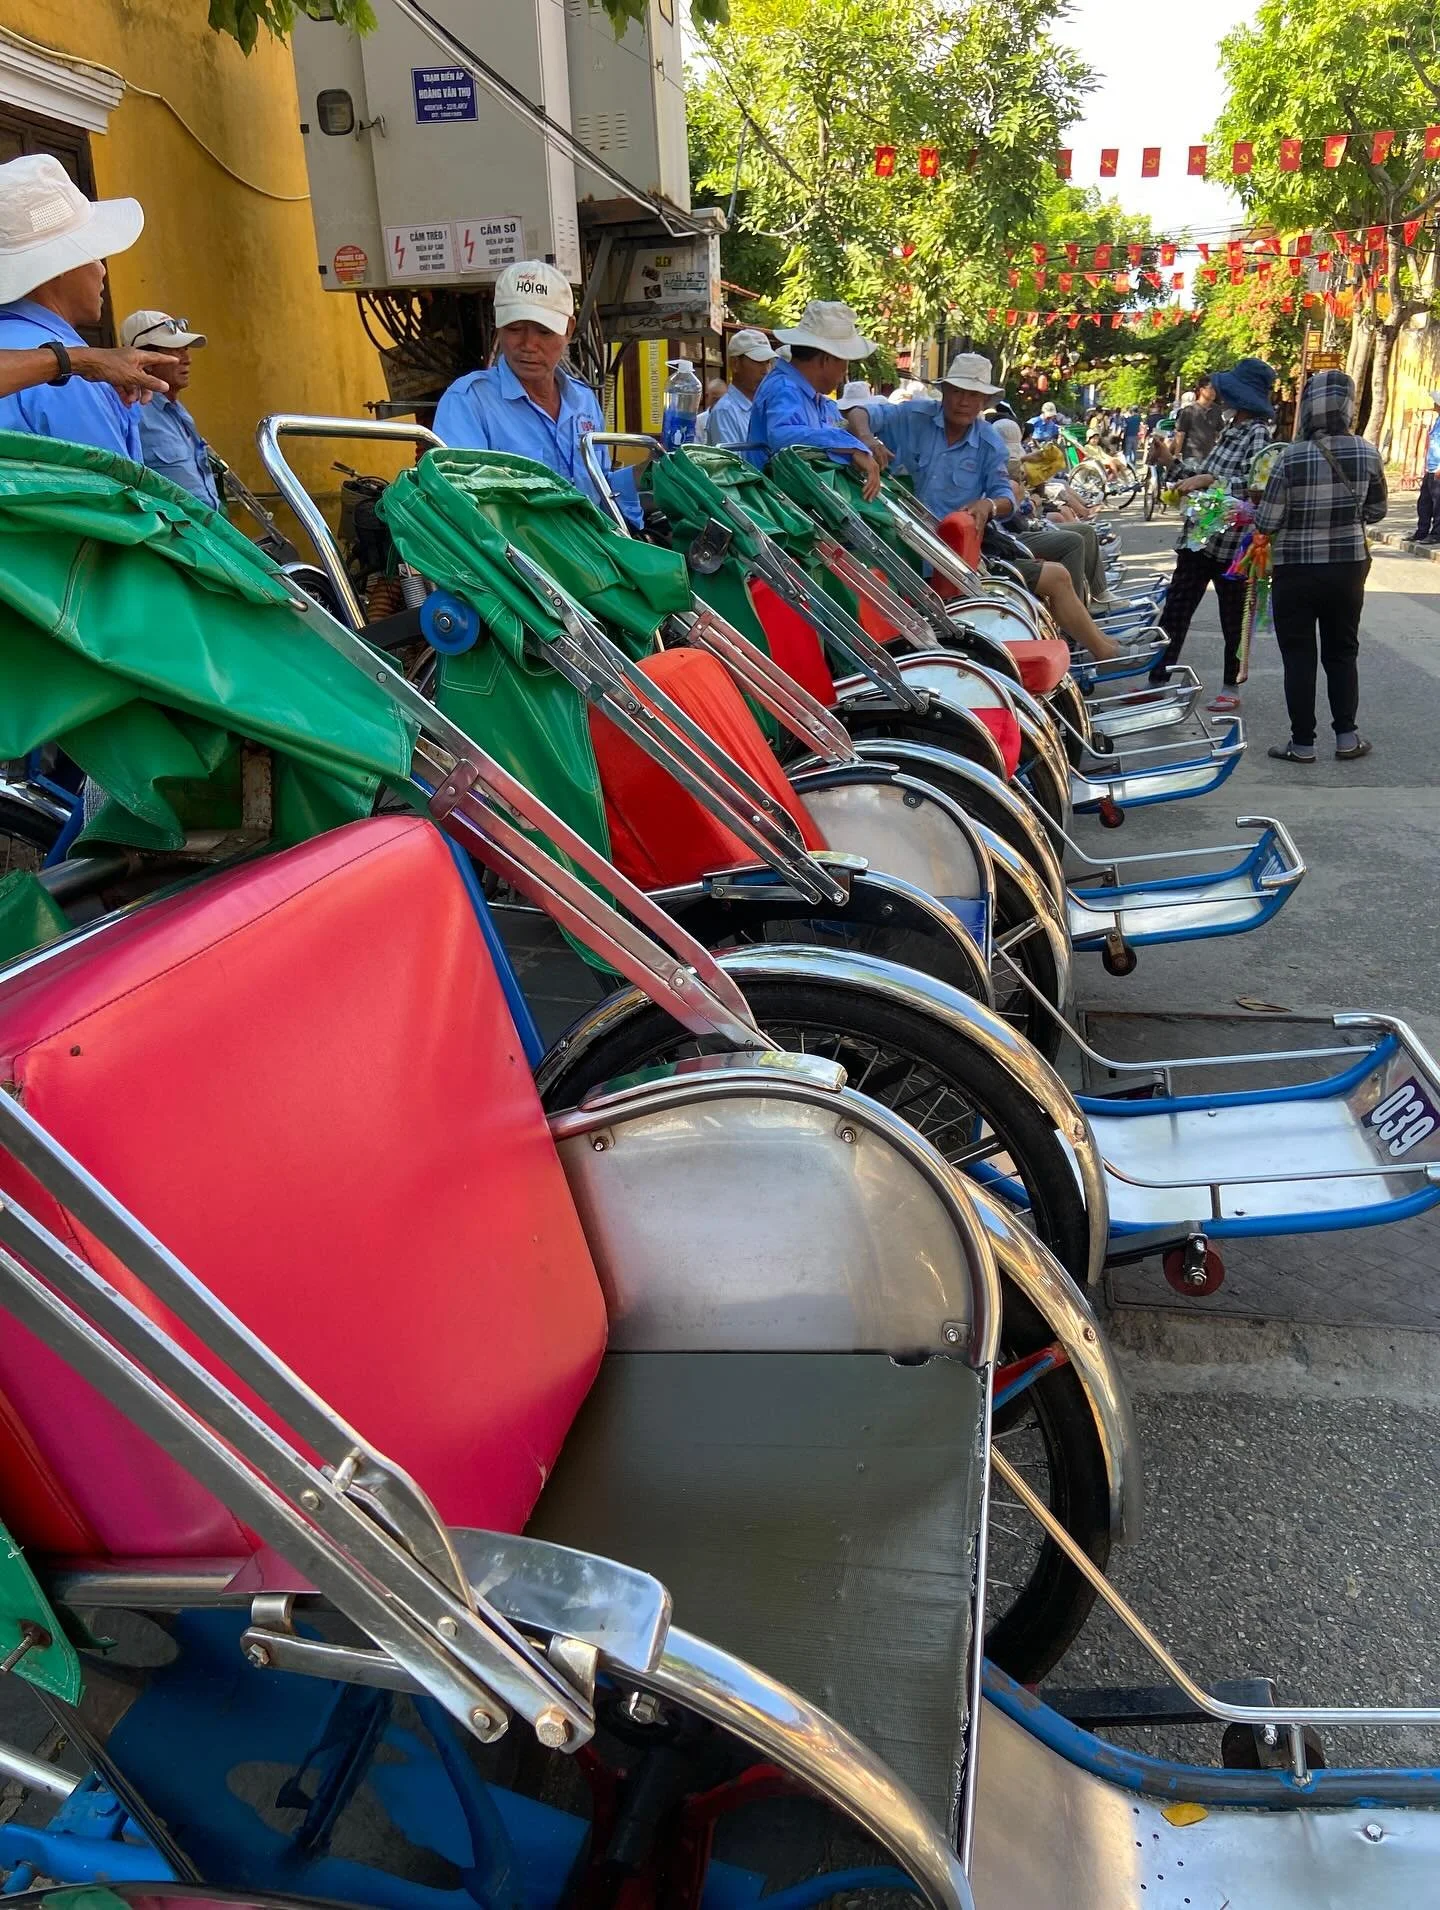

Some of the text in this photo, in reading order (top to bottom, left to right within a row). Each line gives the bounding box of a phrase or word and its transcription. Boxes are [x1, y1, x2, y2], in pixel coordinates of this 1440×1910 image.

[480, 223, 502, 235] CẤM
[409, 231, 426, 242] CẤM
[1371, 1085, 1435, 1157] 039
